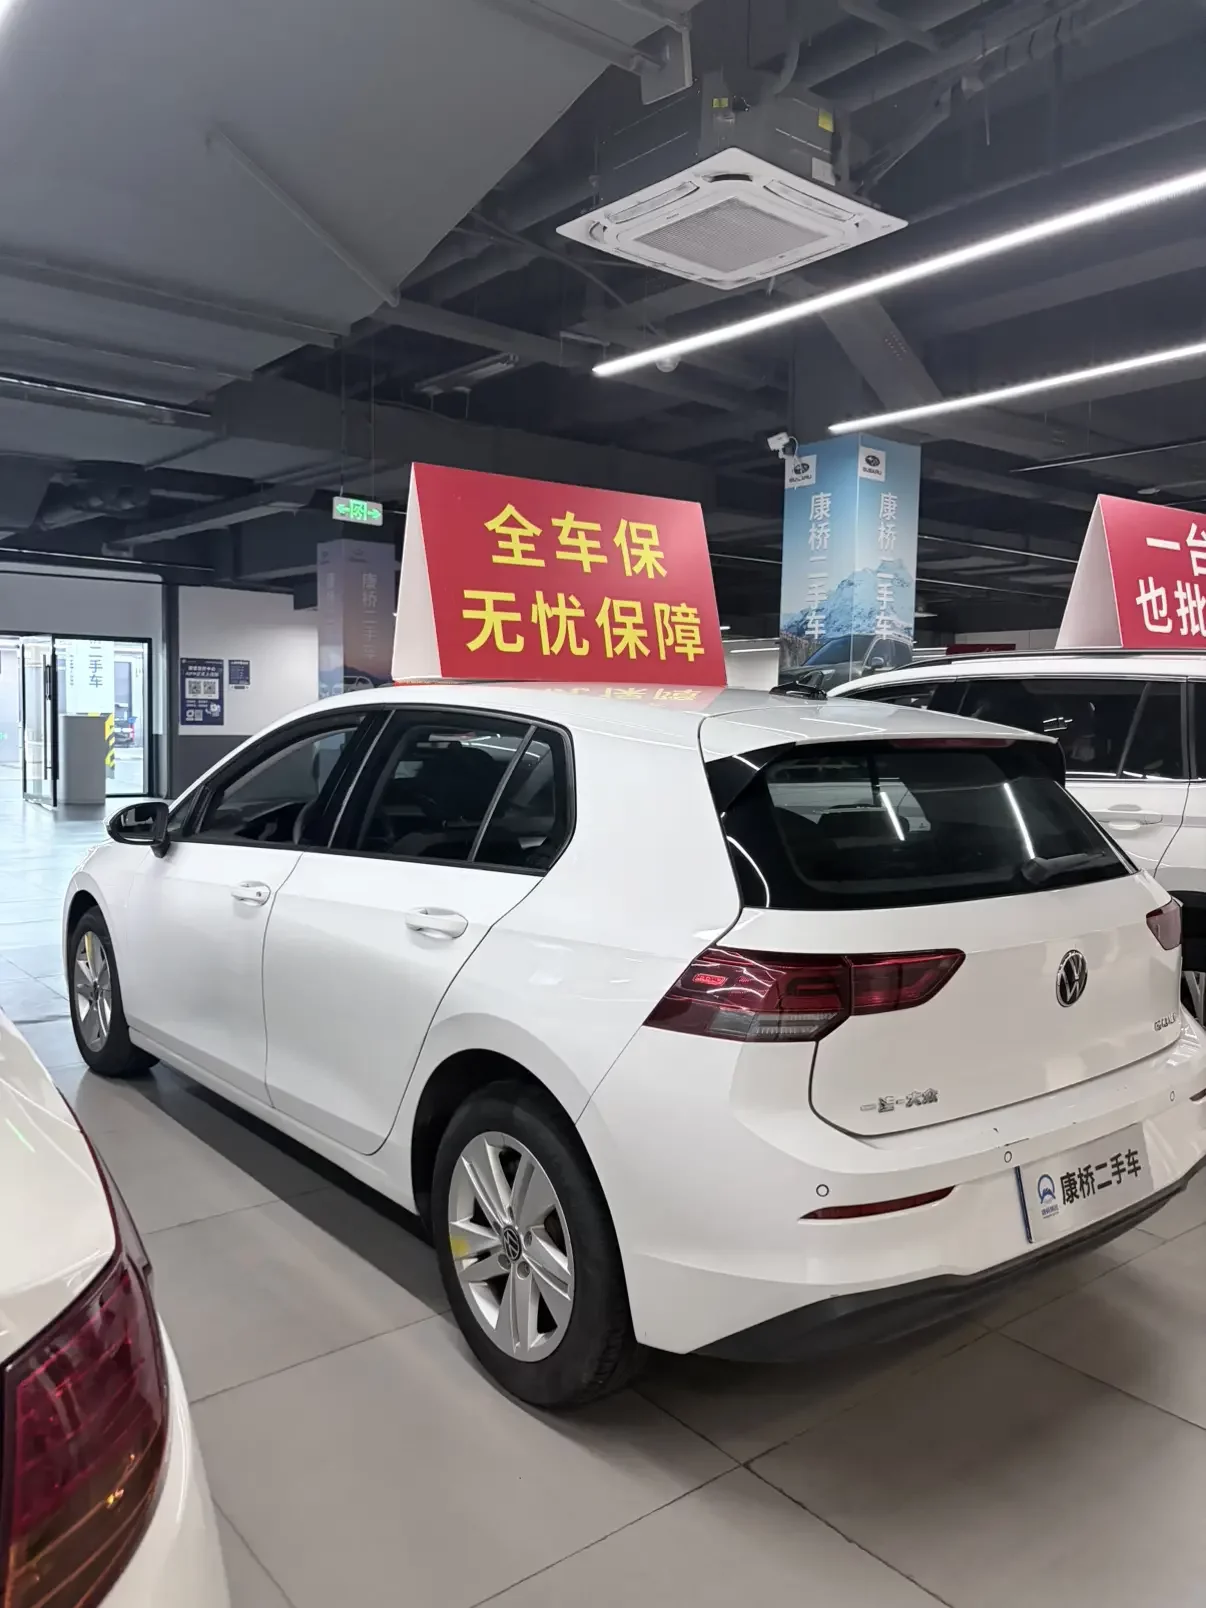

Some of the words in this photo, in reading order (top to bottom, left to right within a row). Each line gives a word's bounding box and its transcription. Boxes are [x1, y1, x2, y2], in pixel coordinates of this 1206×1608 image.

[484, 503, 668, 579] 全车保
[805, 492, 832, 640] 康桥二手车
[875, 492, 898, 640] 康桥二手车
[462, 589, 706, 662] 无忧保障
[1136, 576, 1206, 637] 也批
[88, 640, 104, 688] 二手车
[1060, 1149, 1142, 1205] 康桥二手车
